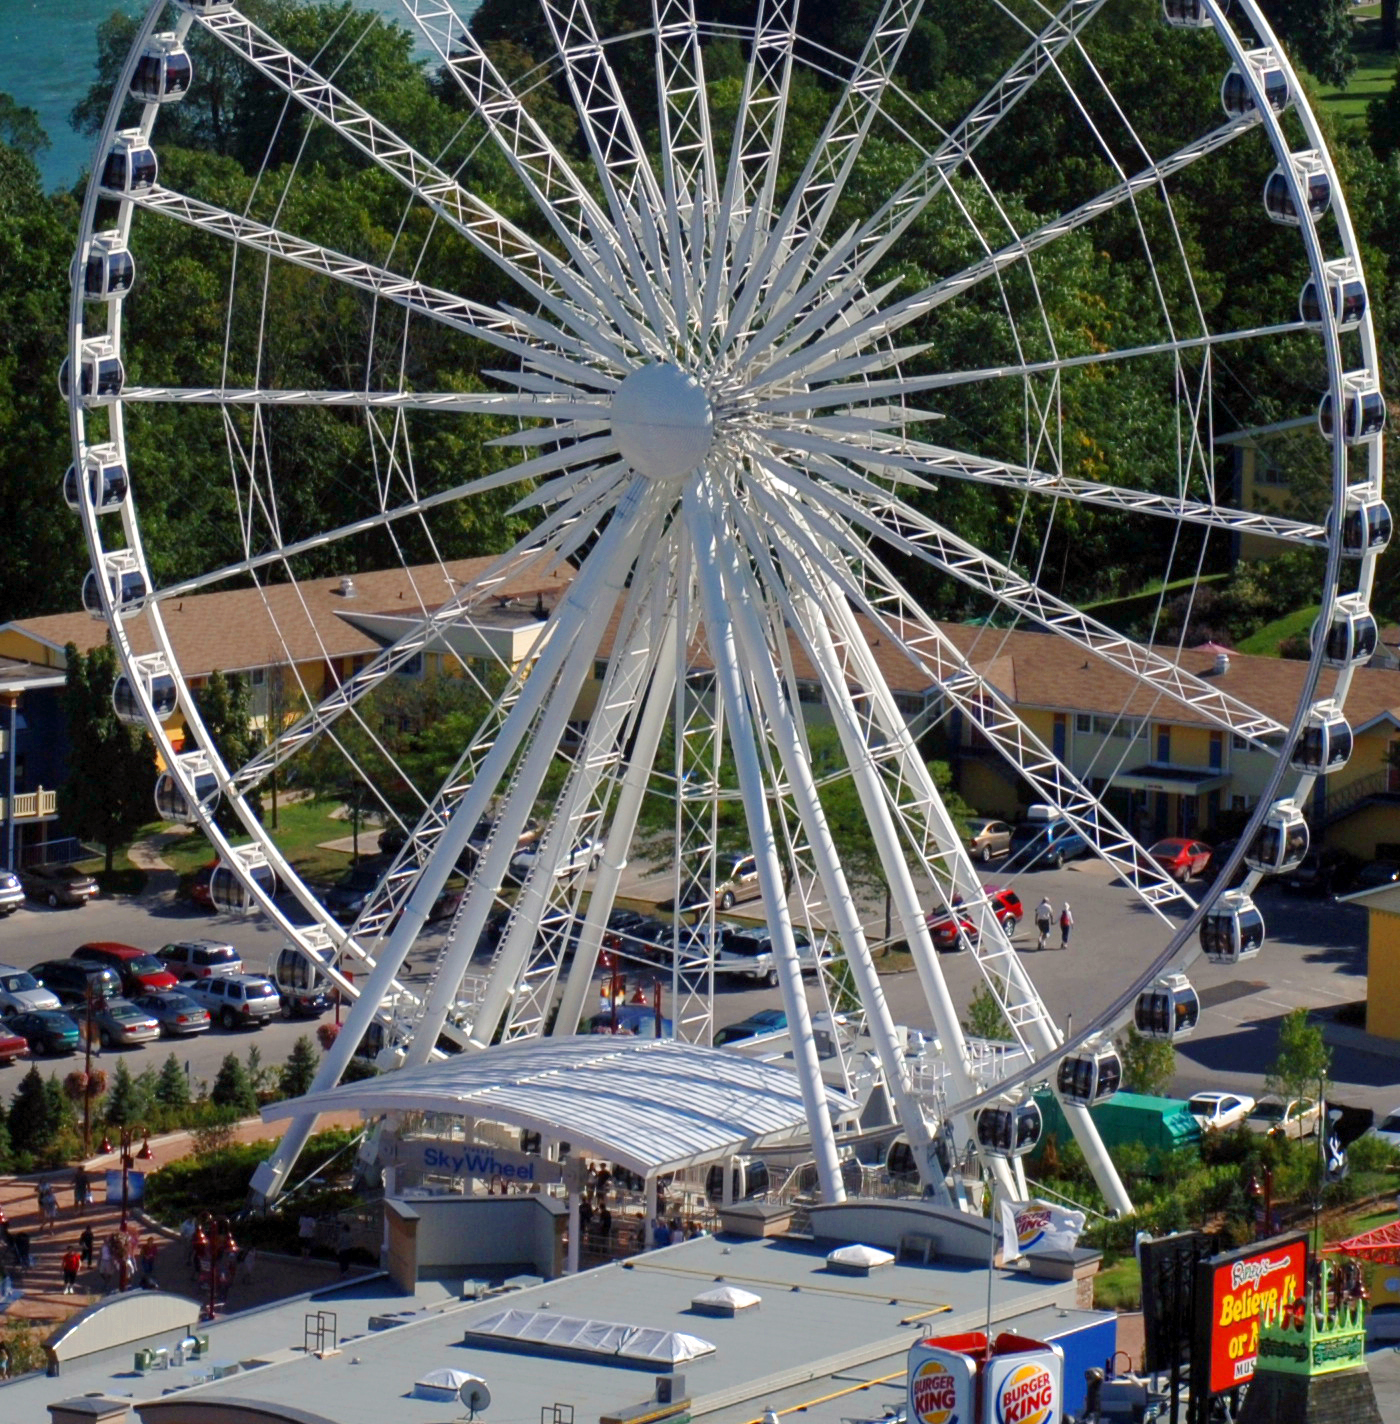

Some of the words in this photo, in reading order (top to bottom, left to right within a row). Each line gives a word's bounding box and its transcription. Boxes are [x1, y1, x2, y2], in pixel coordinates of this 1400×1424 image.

[424, 1147, 535, 1181] SkyWheel
[1219, 1287, 1278, 1326] Believe
[1229, 1333, 1247, 1359] or
[914, 1375, 955, 1394] BURGER
[1003, 1372, 1050, 1408] BURGER
[914, 1389, 956, 1415] KING
[1005, 1386, 1053, 1424] KING
